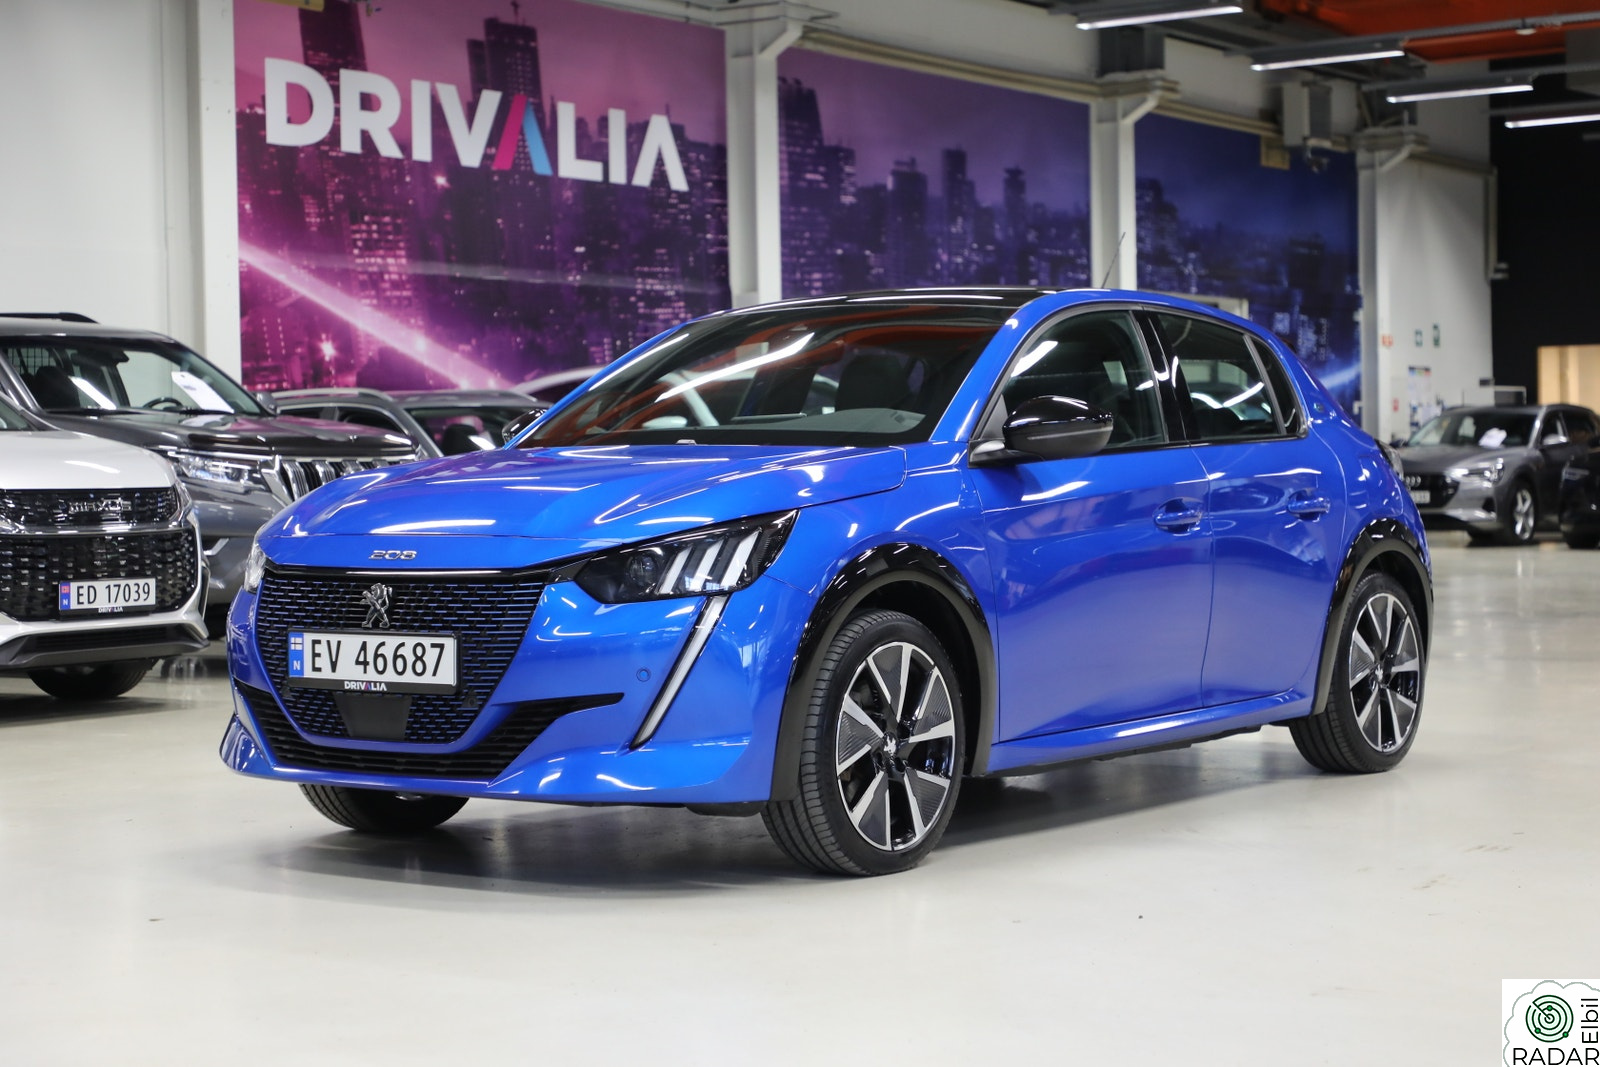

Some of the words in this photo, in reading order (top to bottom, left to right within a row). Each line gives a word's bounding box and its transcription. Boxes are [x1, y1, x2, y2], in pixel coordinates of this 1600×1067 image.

[264, 57, 689, 192] DRIVALIA
[368, 550, 417, 560] 208
[76, 585, 97, 605] ED
[105, 582, 151, 603] 17039
[62, 598, 69, 606] N
[311, 639, 342, 674] EV
[355, 640, 446, 677] 46687
[293, 660, 301, 671] N
[344, 681, 388, 692] DRIVALIA
